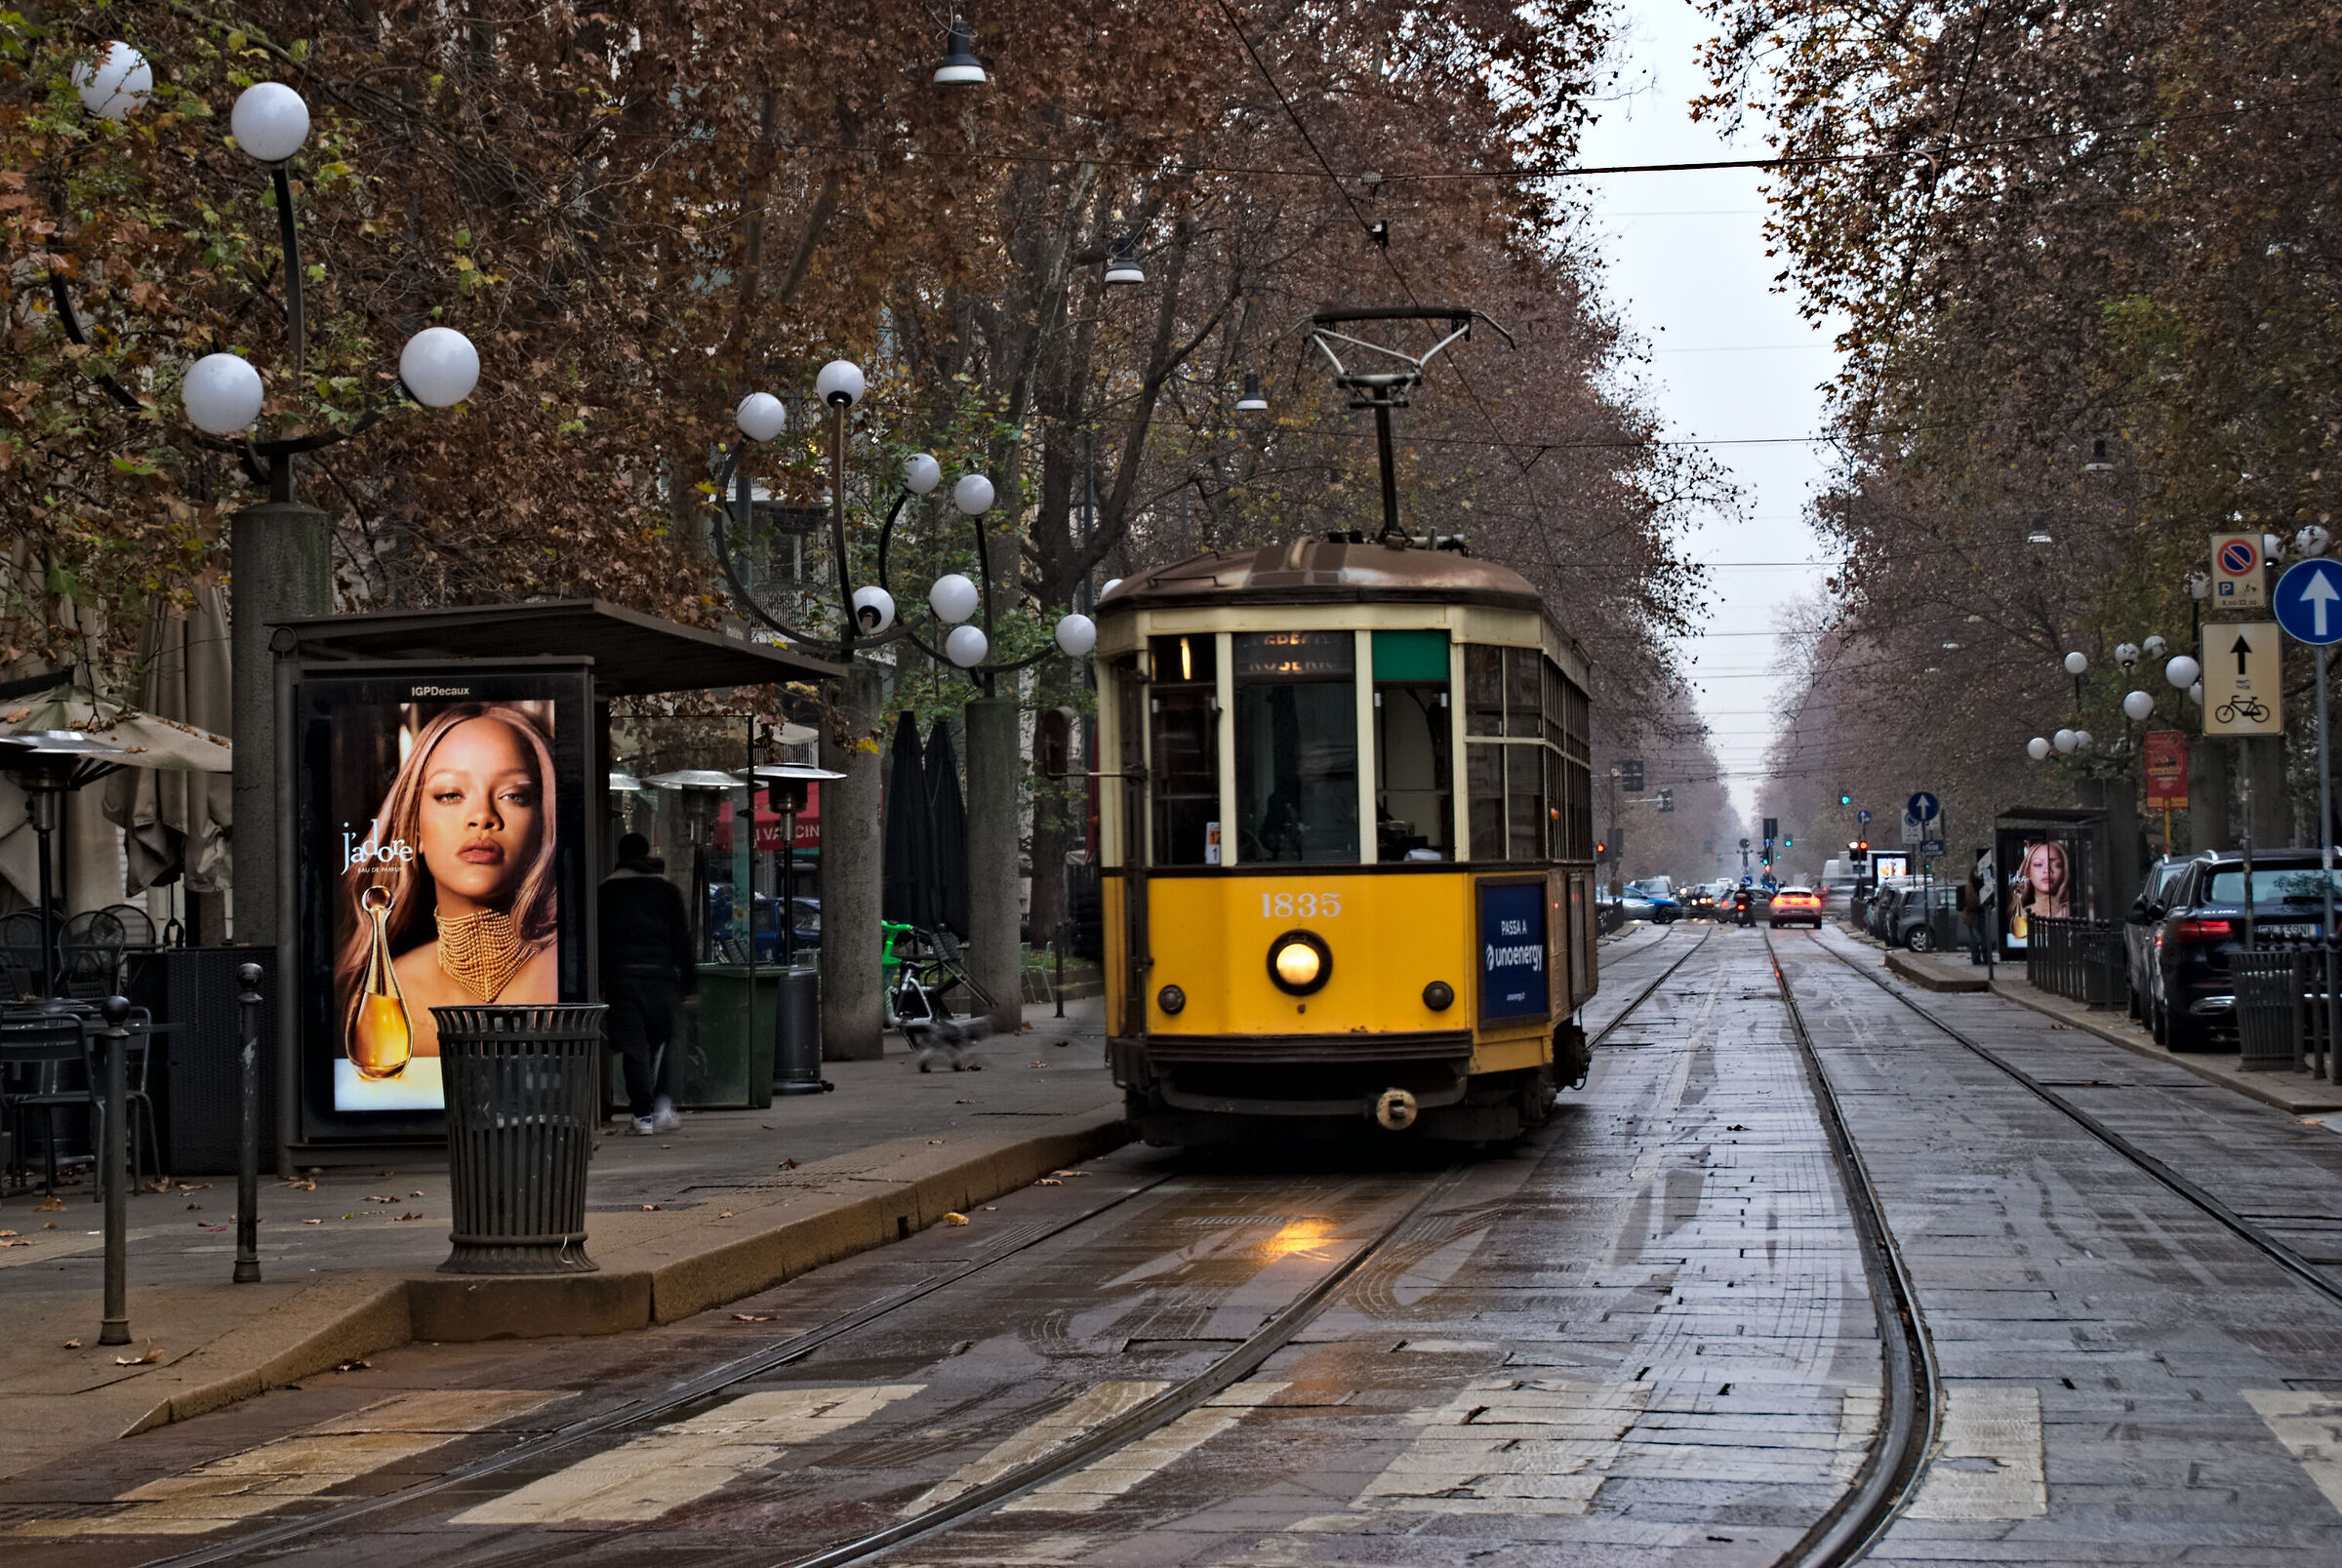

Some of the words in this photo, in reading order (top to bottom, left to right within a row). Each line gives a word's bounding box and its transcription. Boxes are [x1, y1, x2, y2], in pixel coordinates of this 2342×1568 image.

[411, 686, 470, 697] IGPDecaux
[341, 819, 414, 876] j'adore
[1261, 892, 1342, 918] 1835
[1501, 919, 1521, 937] PASSA
[1521, 918, 1528, 935] A
[1495, 944, 1543, 972] unoenergy
